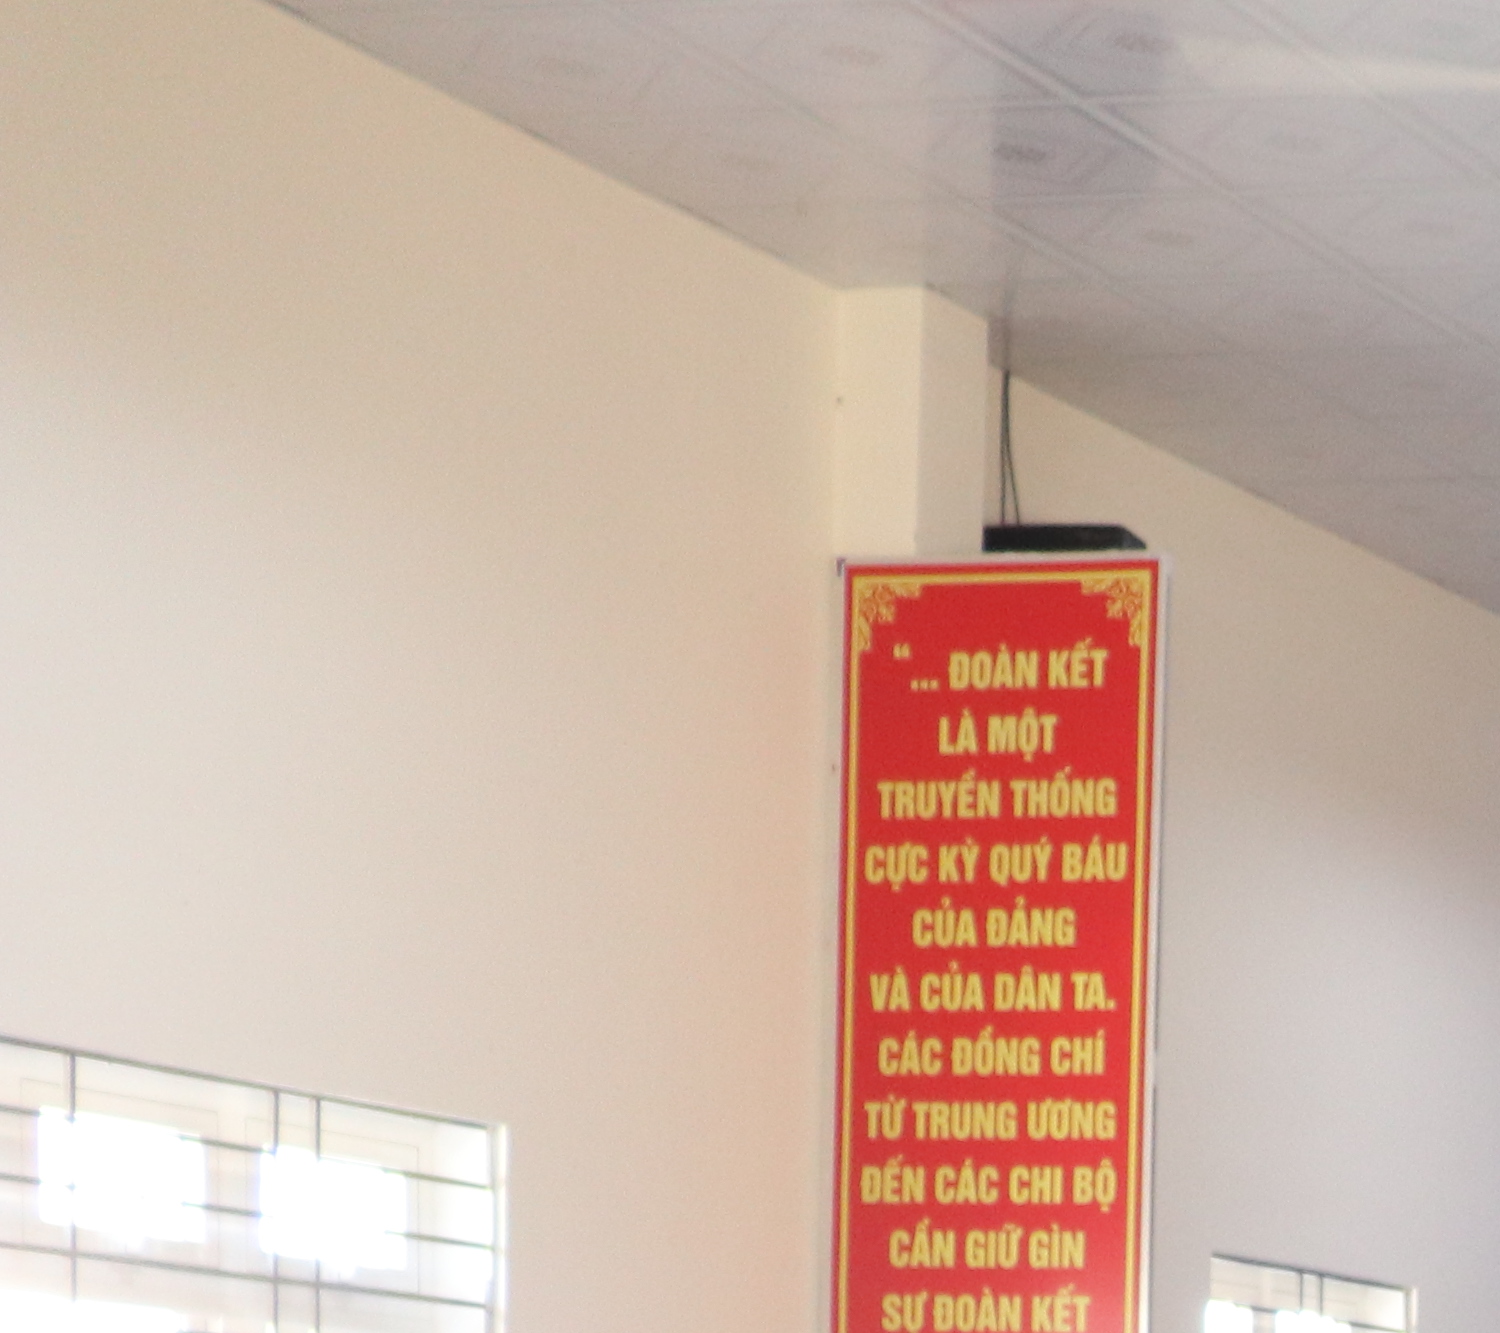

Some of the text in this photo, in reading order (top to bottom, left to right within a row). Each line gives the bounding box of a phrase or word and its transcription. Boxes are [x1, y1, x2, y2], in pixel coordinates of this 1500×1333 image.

[948, 638, 1108, 690] ĐOÀN KẾT
[939, 707, 1058, 761] LÀ MỘT
[865, 836, 1129, 891] CỰC KỲ QUÝ BÁU
[912, 896, 1076, 948] CỦA ĐẢNG
[870, 966, 911, 1011] VÀ
[920, 961, 985, 1012] CỦA
[994, 966, 1062, 1011] DÂN
[864, 1095, 1117, 1140] TỪ TRUNG ƯƠNG
[860, 1155, 1117, 1212] ĐẾN CÁC CHI BỘ
[933, 1288, 1023, 1333] ĐOÀN
[1031, 1284, 1092, 1333] KẾT
